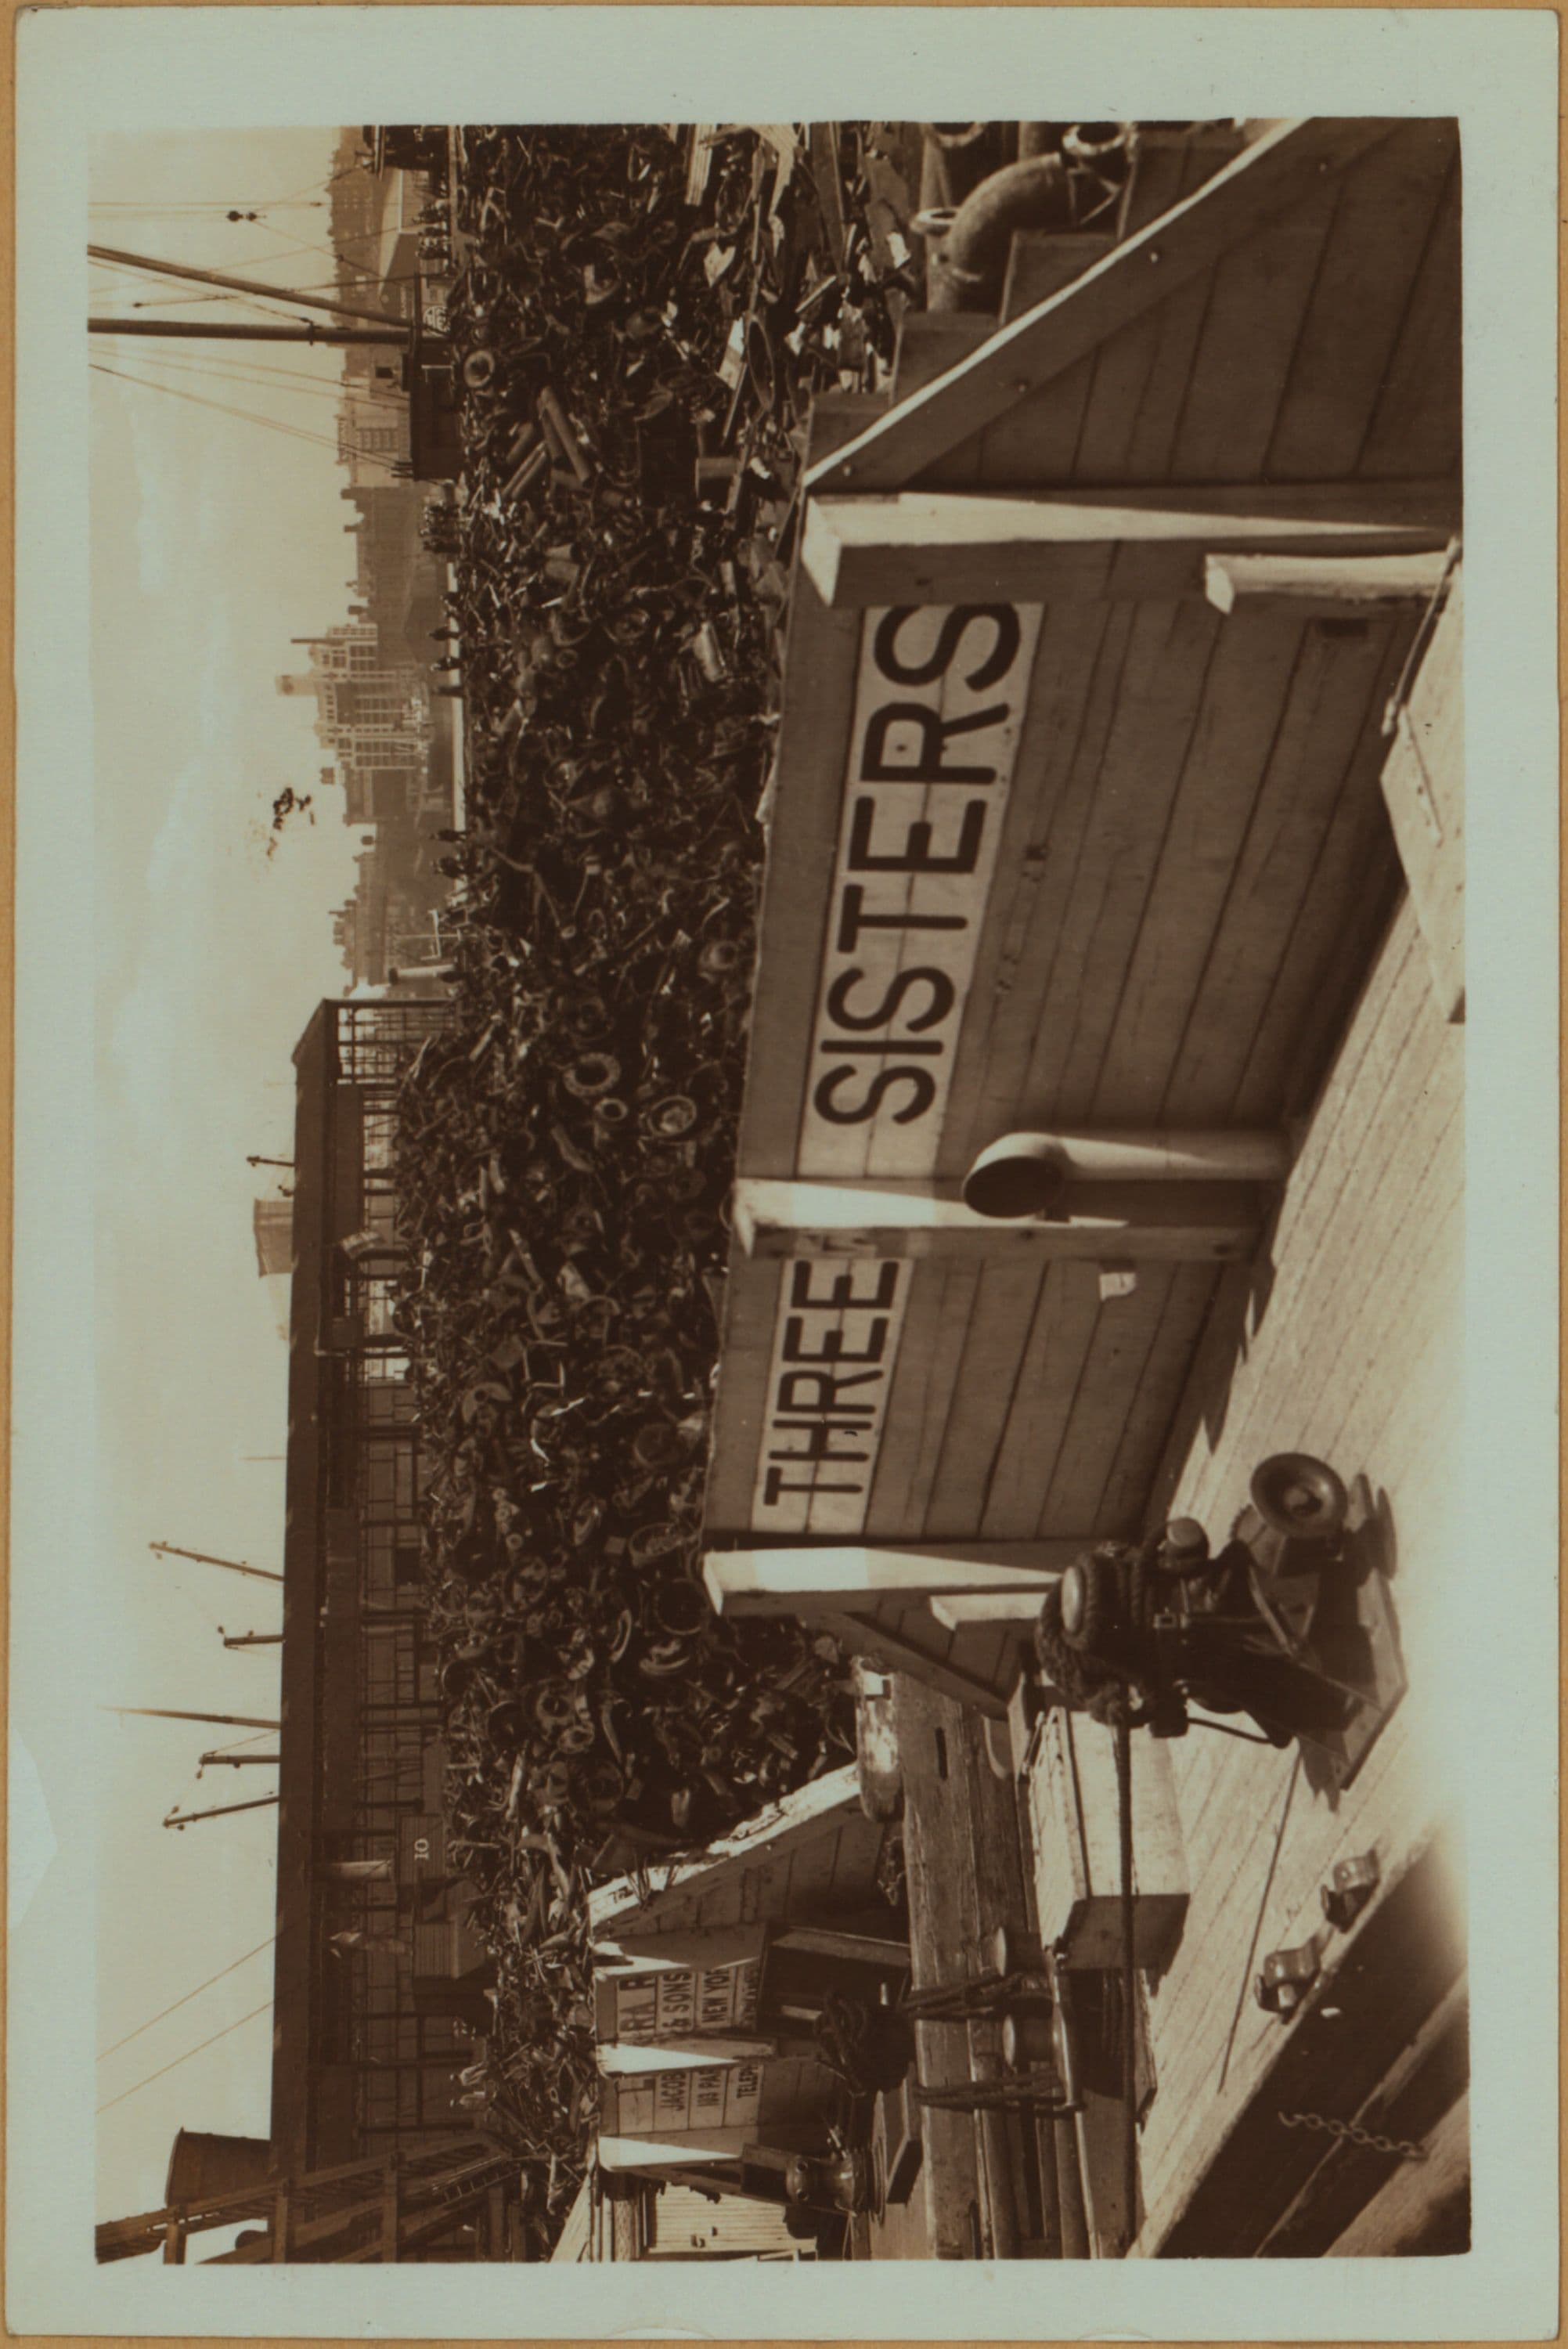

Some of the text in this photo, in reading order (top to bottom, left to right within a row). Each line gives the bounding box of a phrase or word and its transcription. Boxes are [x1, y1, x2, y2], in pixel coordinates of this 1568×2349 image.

[762, 602, 1021, 1506] THREE SISTERS
[414, 1838, 430, 1861] 10
[662, 1972, 692, 2013] SONS
[701, 1997, 728, 2022] NEW
